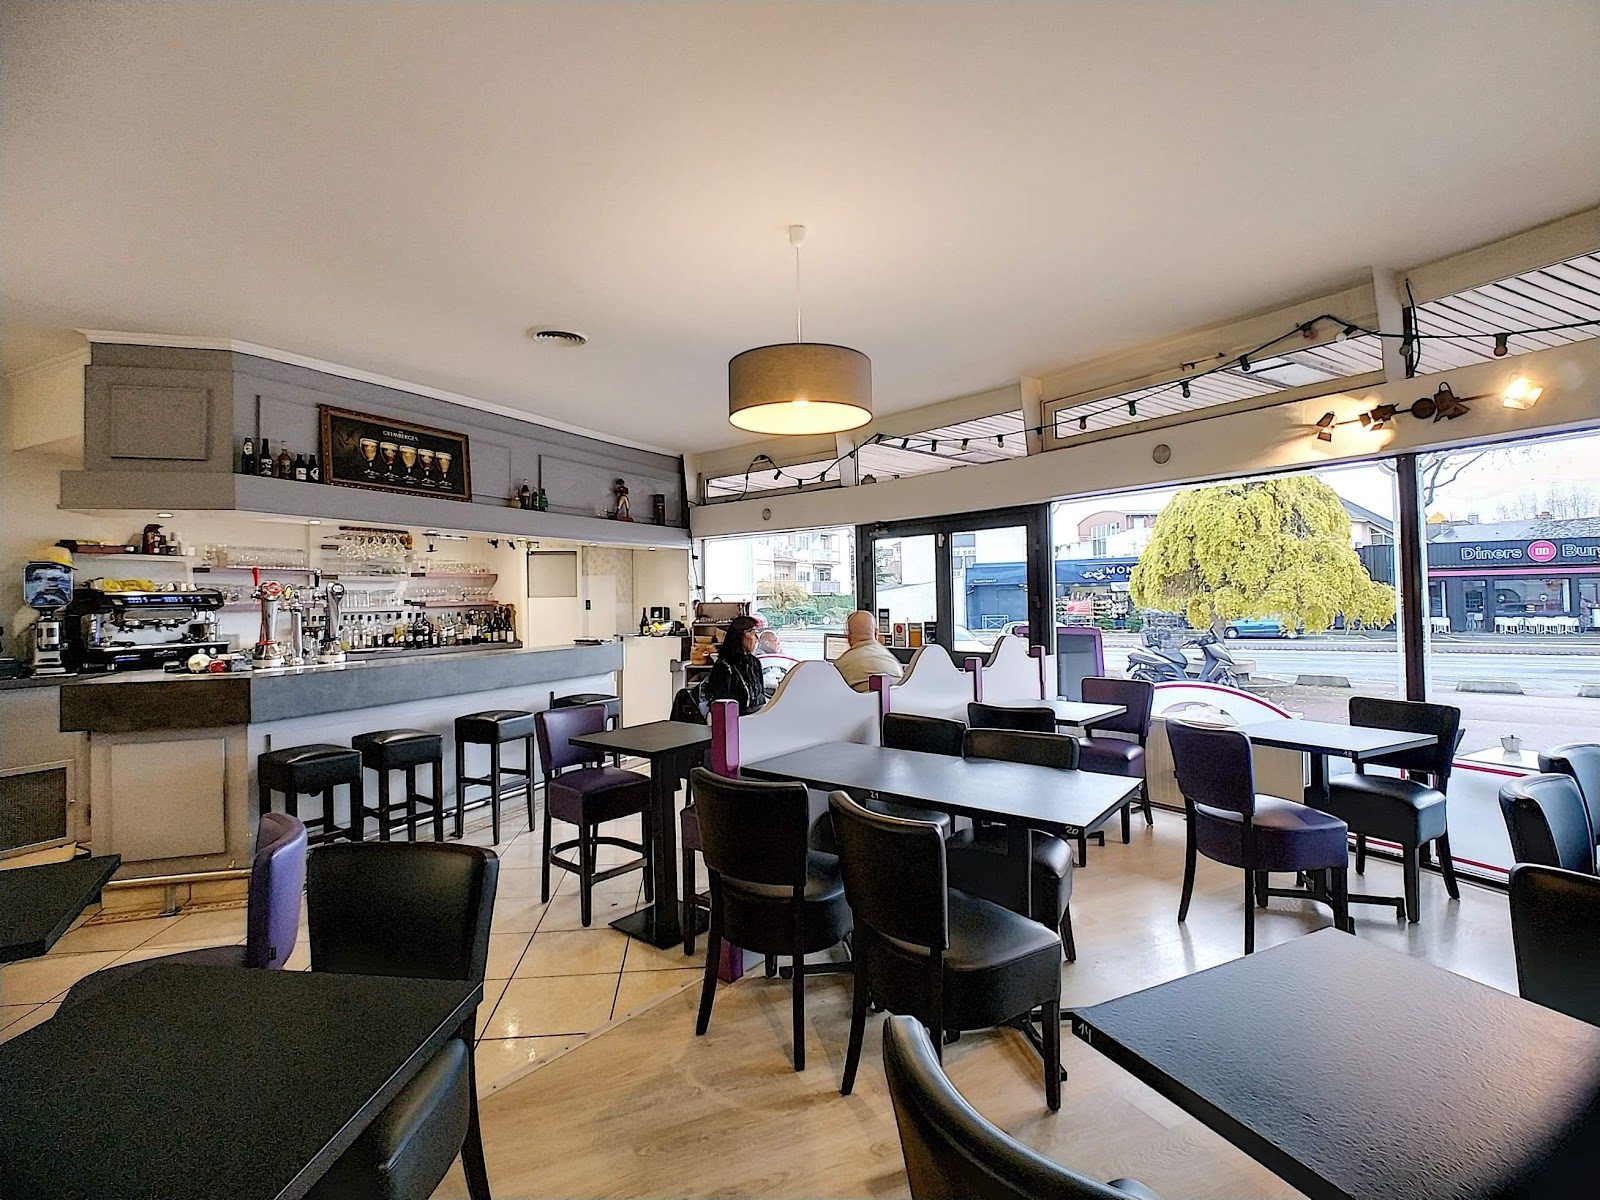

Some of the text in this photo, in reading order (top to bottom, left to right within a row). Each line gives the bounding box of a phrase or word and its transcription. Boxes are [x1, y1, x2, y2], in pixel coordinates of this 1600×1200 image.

[1461, 546, 1523, 560] Diners
[870, 790, 879, 799] 21
[1065, 825, 1079, 835] 20
[1078, 1022, 1092, 1044] 14
